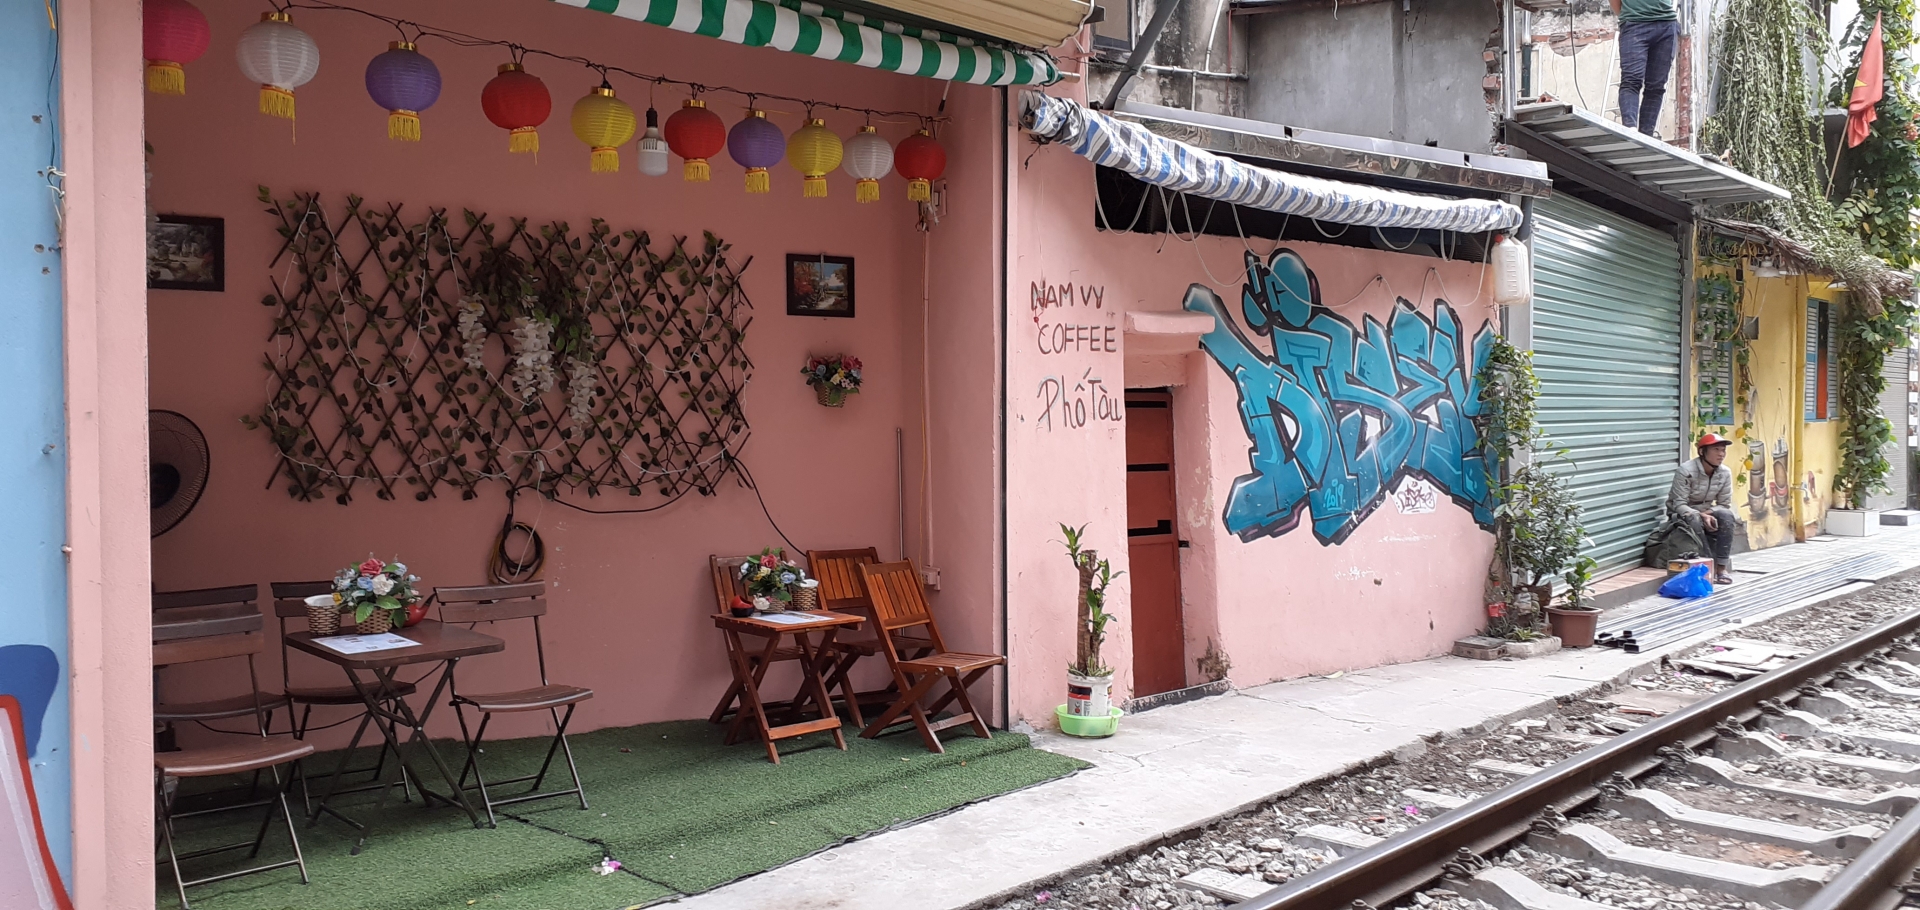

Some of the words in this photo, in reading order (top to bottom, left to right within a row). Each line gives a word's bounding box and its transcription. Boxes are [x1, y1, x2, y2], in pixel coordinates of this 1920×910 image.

[1031, 280, 1074, 311] NAM
[1038, 323, 1117, 354] COFFEE
[1037, 367, 1092, 432] Phố
[1088, 379, 1123, 421] Tàu
